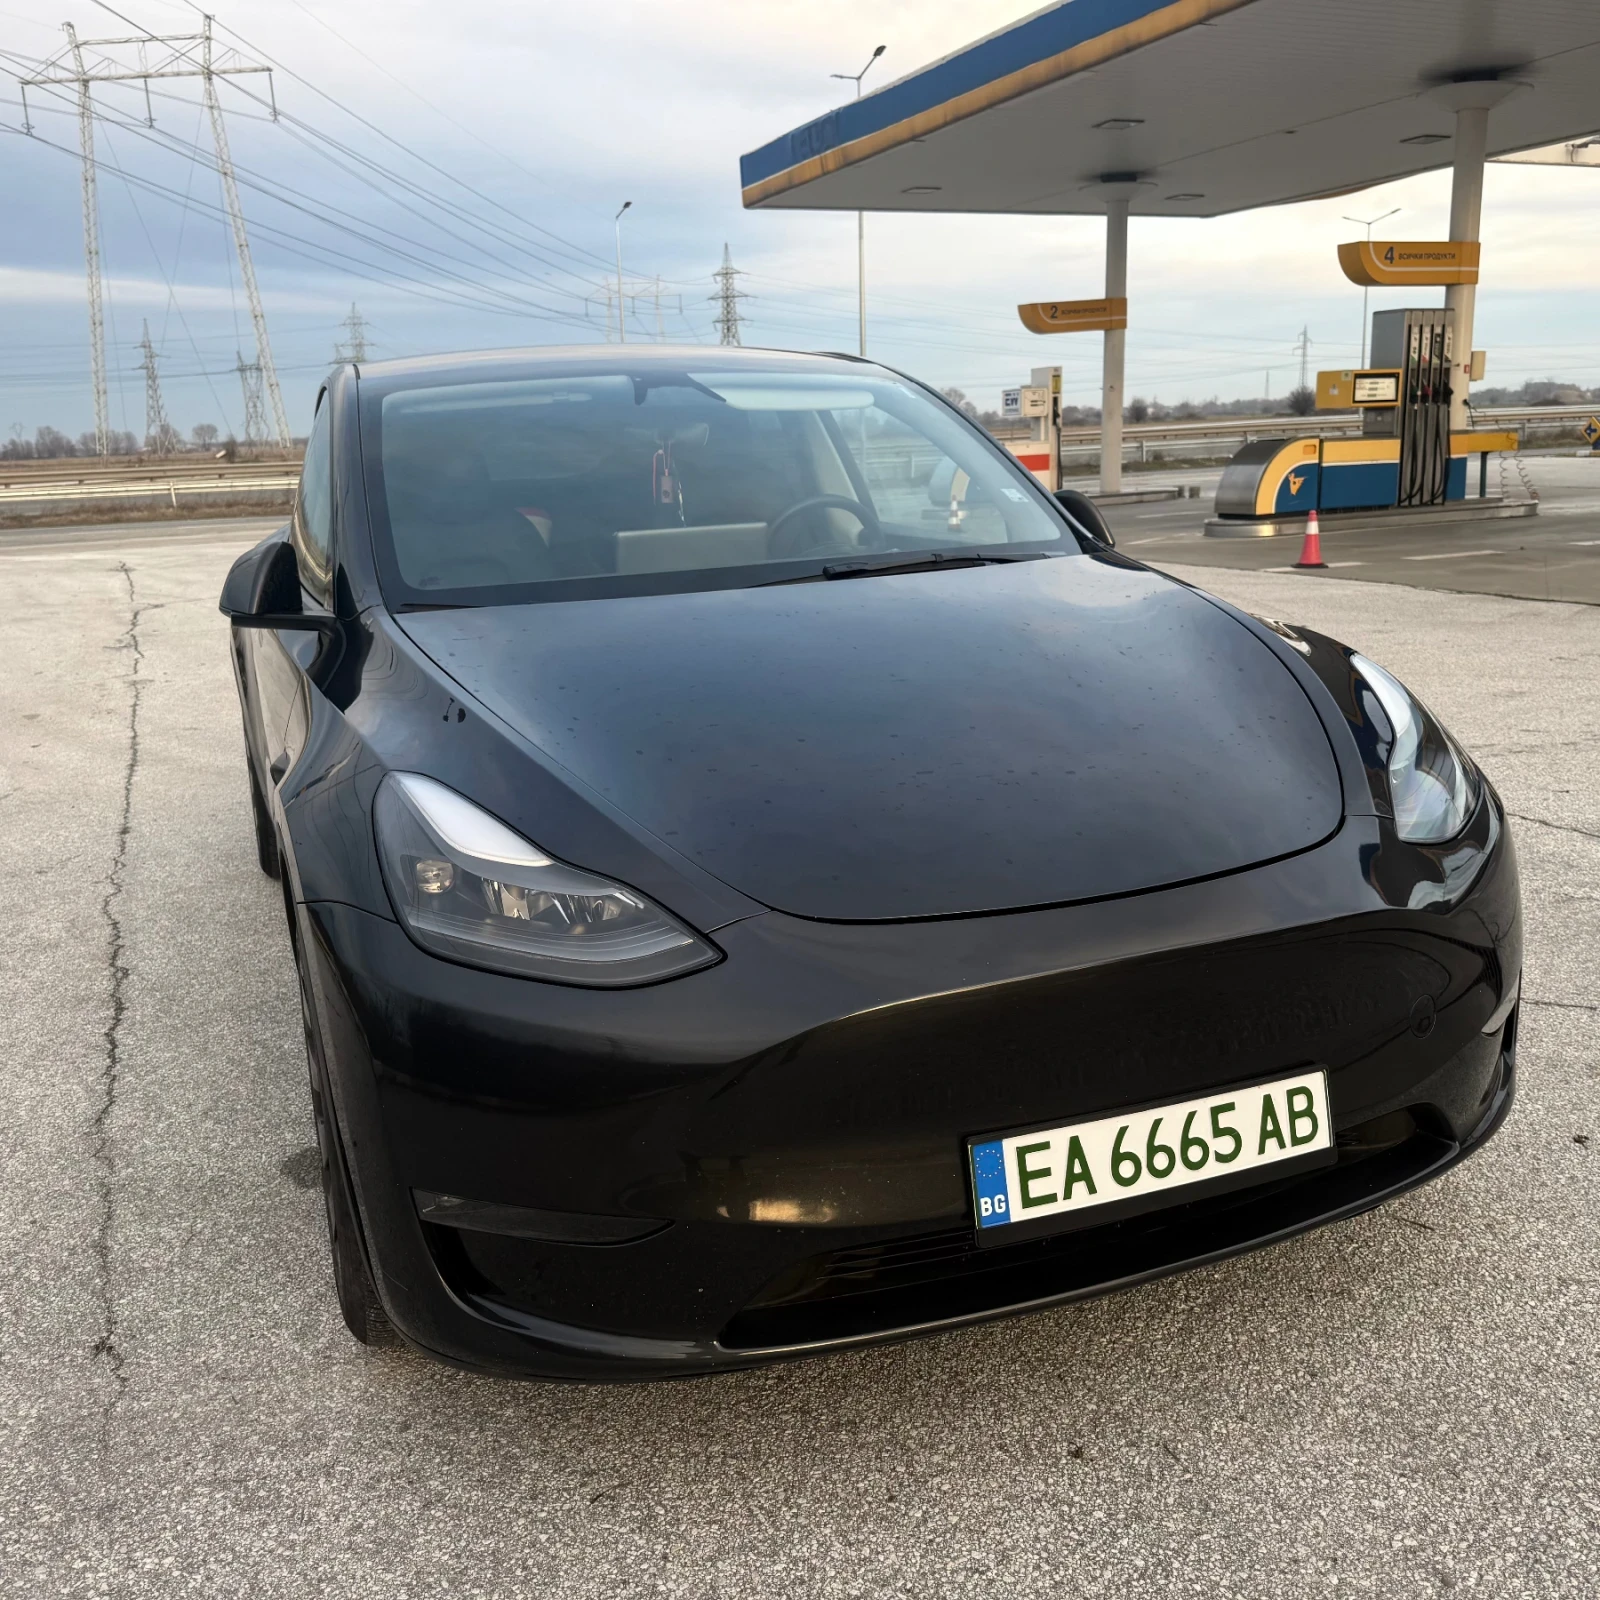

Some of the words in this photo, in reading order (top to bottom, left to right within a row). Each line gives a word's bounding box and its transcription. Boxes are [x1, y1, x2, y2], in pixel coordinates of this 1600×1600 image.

[1384, 246, 1395, 265] 4
[1050, 304, 1059, 319] 2
[1016, 1135, 1098, 1209] EA
[1110, 1101, 1243, 1187] 6665
[1258, 1085, 1319, 1155] AB
[980, 1194, 1006, 1216] BG
